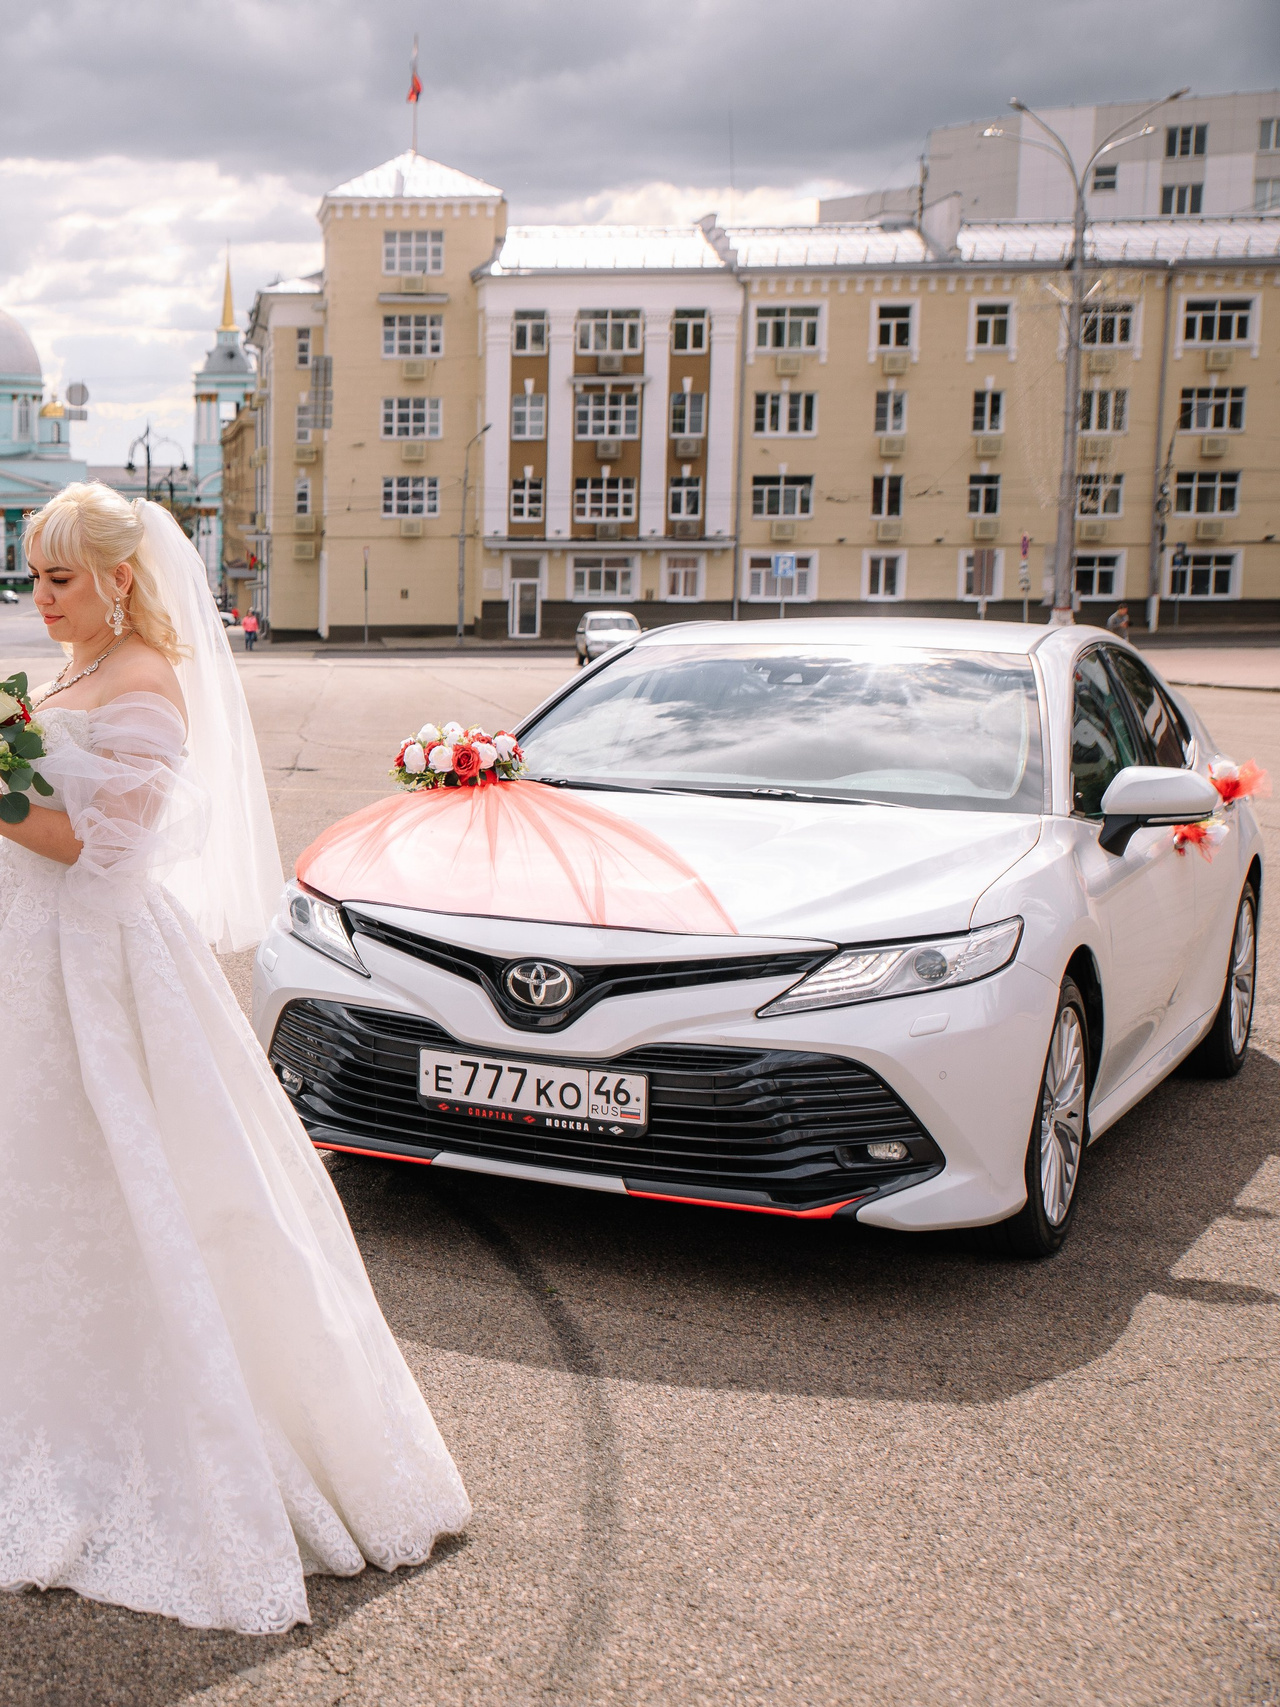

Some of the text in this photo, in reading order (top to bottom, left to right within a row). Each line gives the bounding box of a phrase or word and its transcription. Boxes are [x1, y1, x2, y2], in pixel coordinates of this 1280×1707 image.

[593, 1076, 631, 1106] 46
[468, 1107, 590, 1132] СПАРТАК МОСКВА
[590, 1104, 619, 1117] RUS
